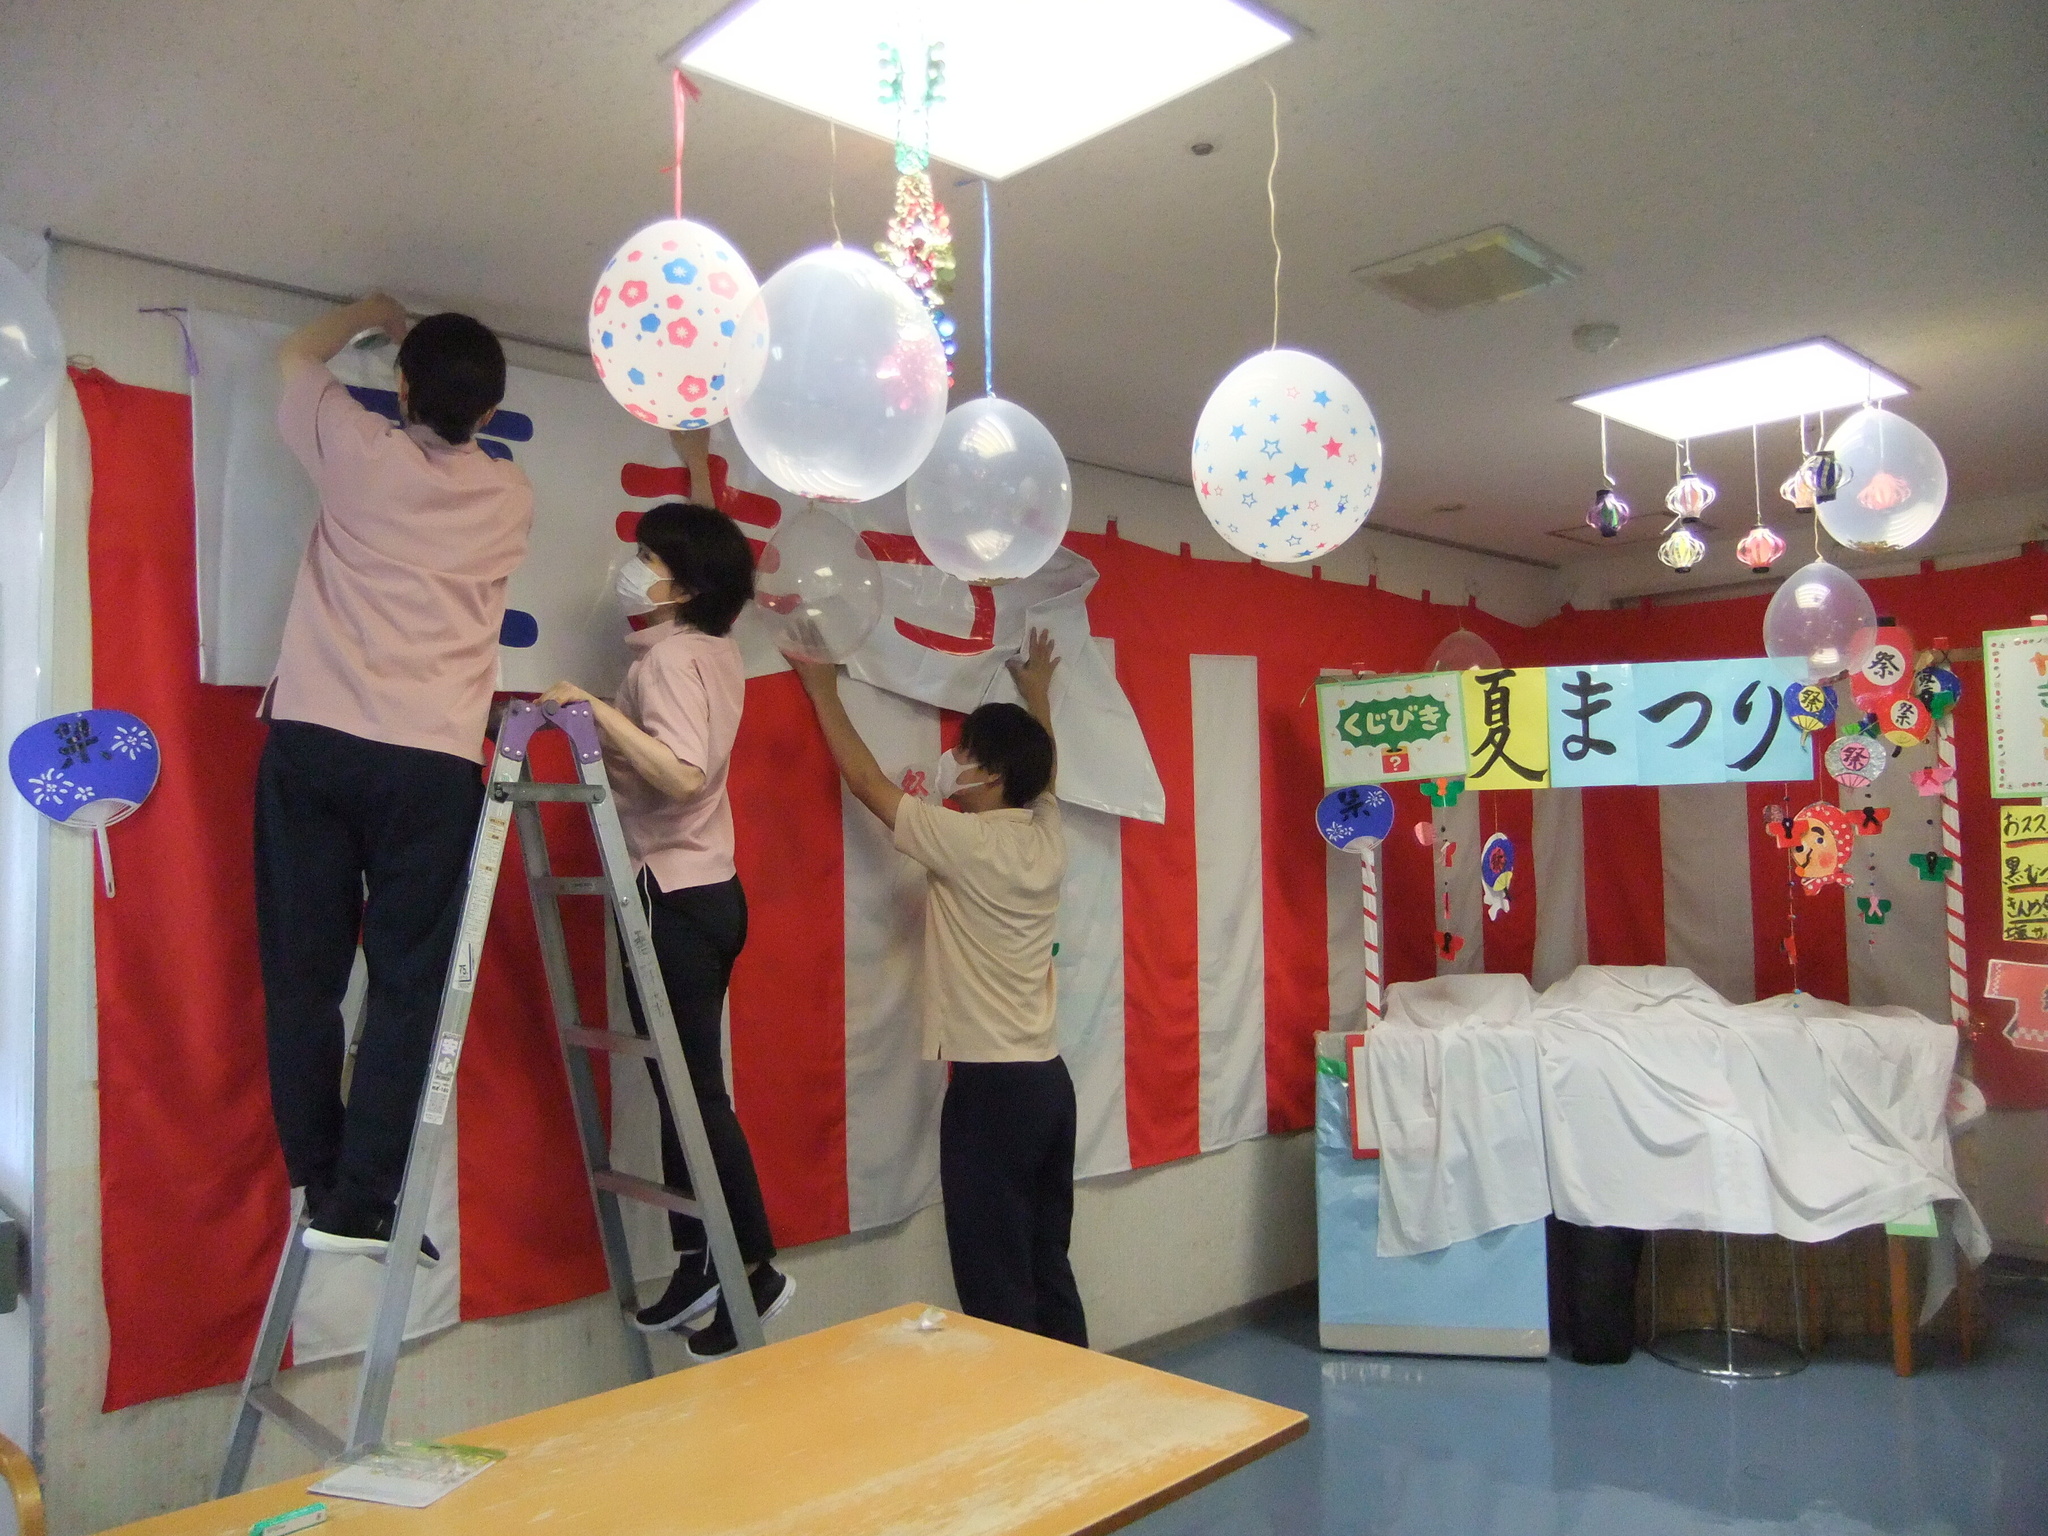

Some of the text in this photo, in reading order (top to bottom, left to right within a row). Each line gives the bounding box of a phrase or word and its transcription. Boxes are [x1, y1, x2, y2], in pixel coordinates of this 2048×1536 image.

[1868, 650, 1900, 679] 祭
[1800, 688, 1823, 712] 祭
[1344, 704, 1441, 737] くじびき
[1468, 669, 1783, 774] 夏まつり
[1895, 701, 1914, 726] 祭
[1843, 746, 1868, 771] 祭
[2003, 811, 2048, 837] おスス
